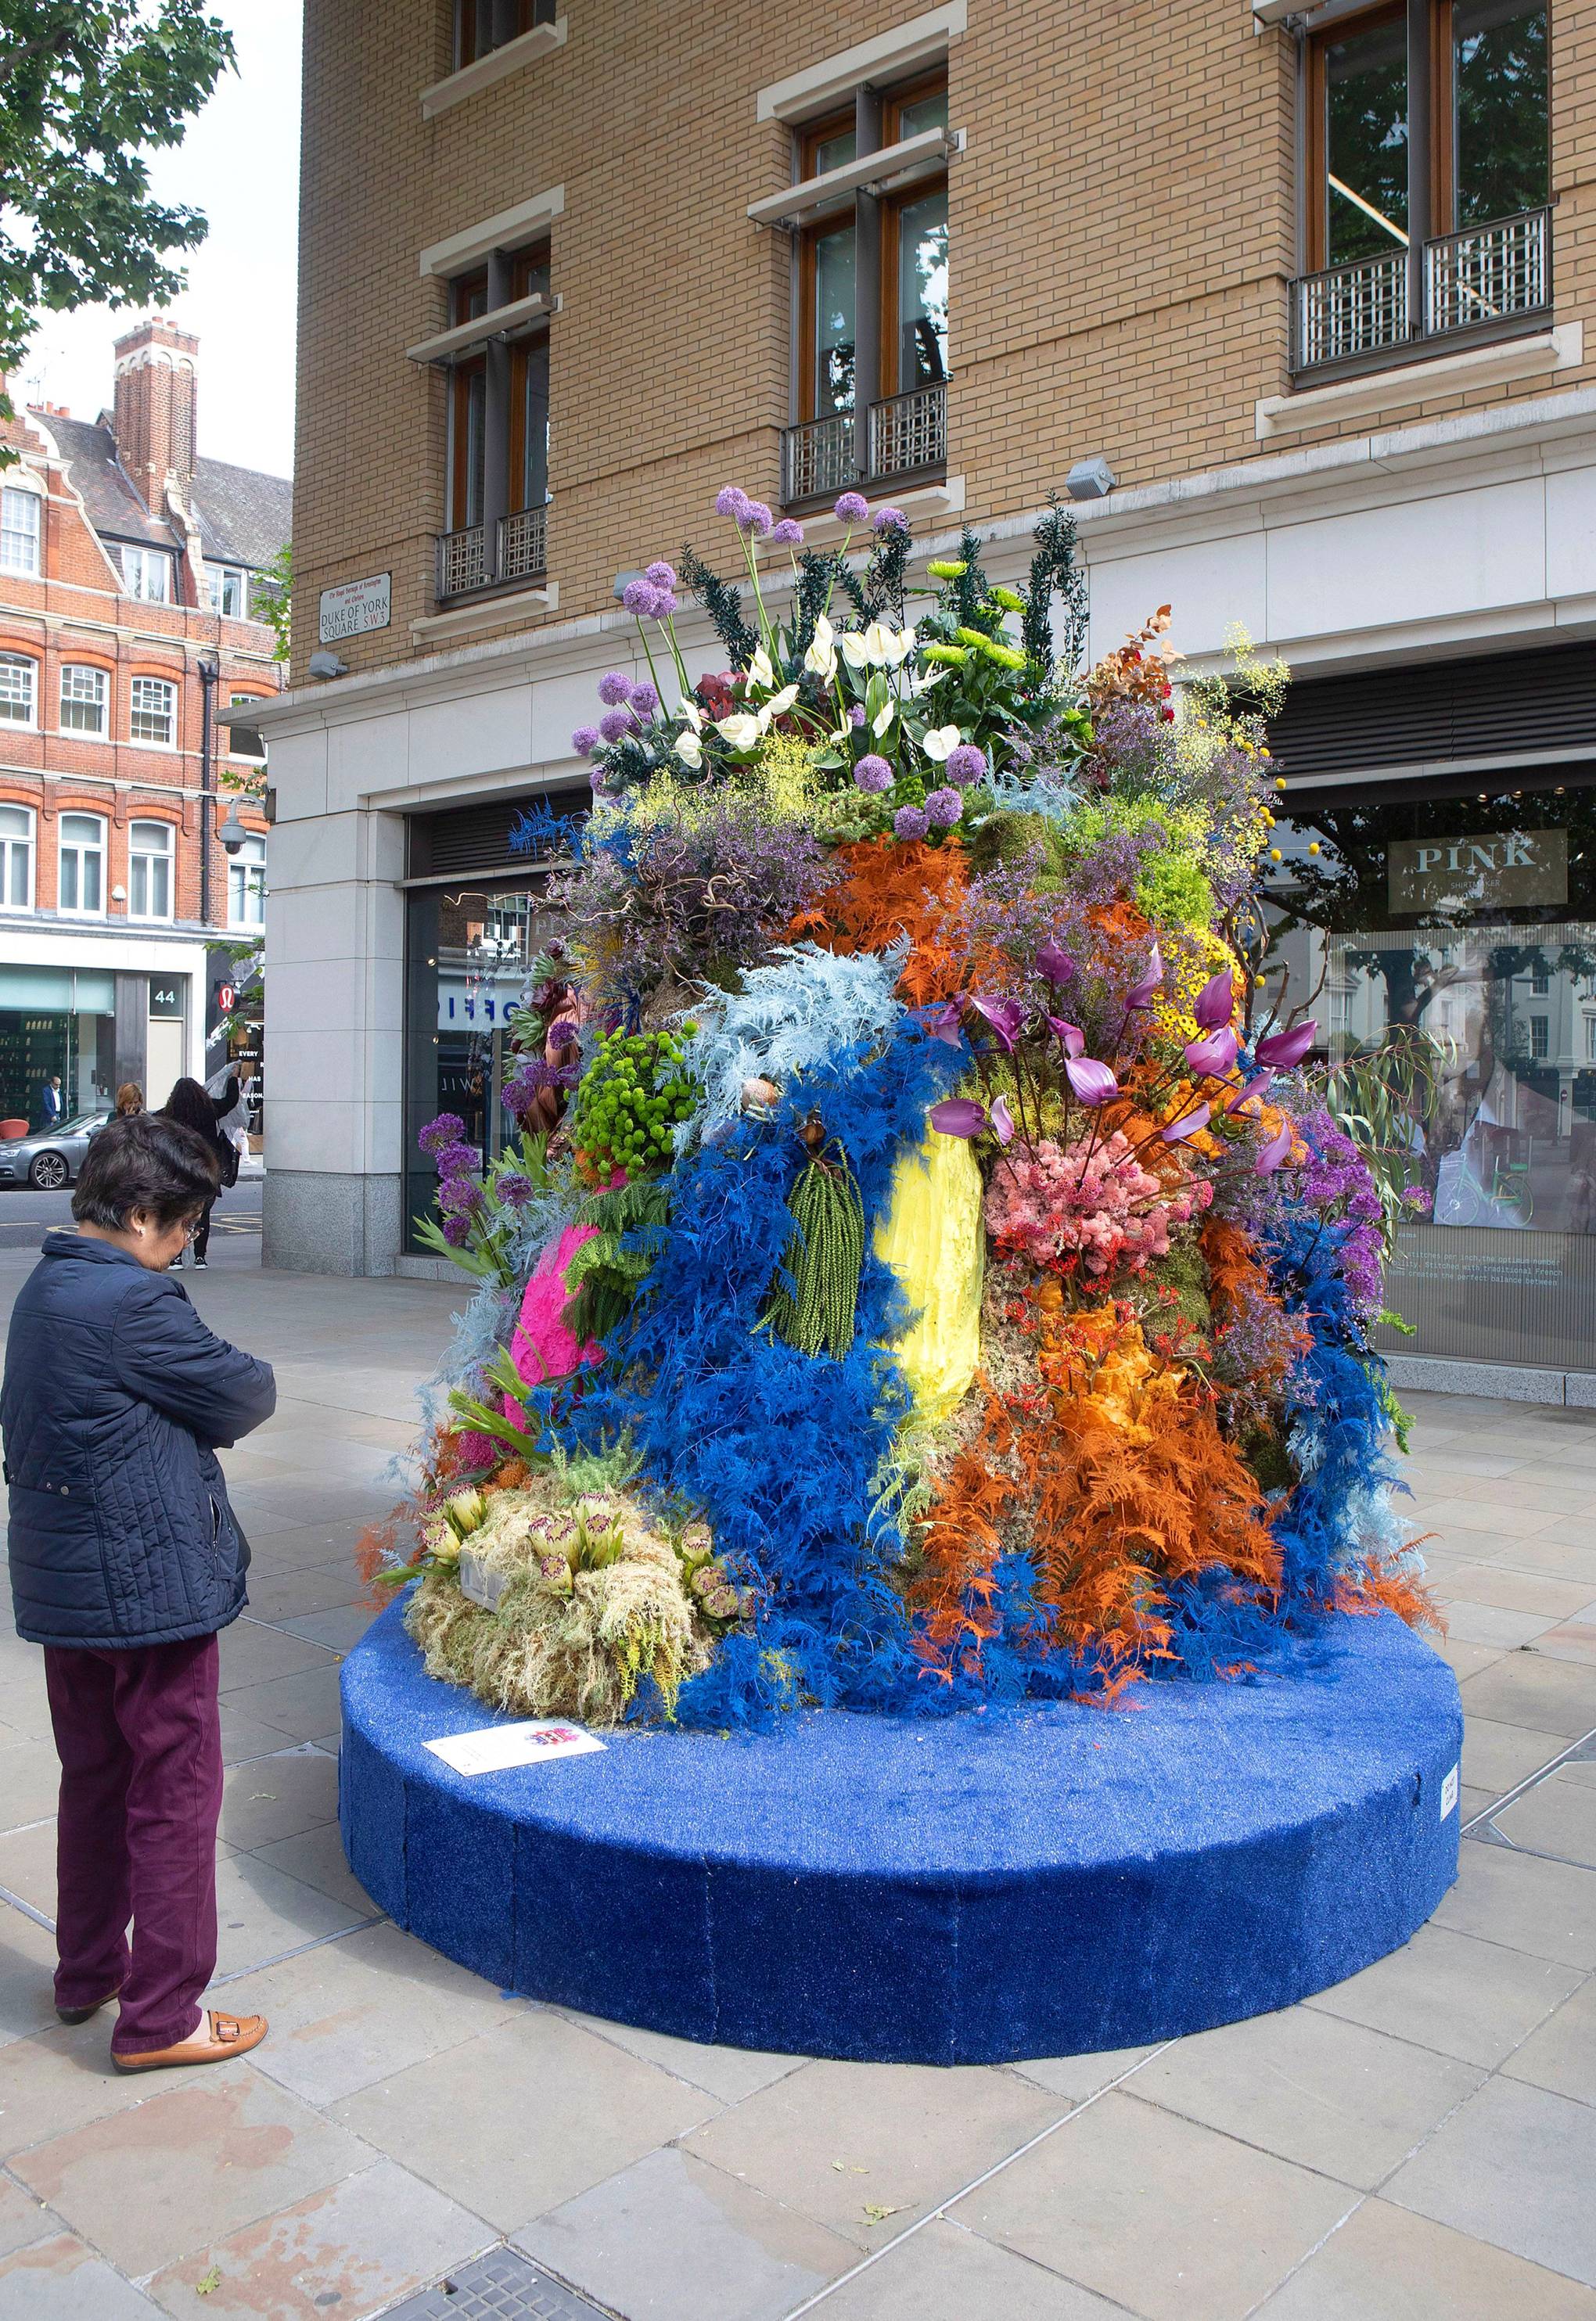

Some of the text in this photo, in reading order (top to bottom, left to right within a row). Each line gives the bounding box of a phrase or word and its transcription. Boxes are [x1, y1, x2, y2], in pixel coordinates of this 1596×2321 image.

[322, 596, 388, 627] DUKE OF YORK
[324, 612, 385, 639] SQUARE S.W.3
[1415, 843, 1537, 873] PINK
[1450, 879, 1501, 889] SHIRTMKER
[155, 990, 175, 1004] 44
[1425, 1261, 1458, 1270] Stitched
[1484, 1265, 1531, 1274] traditional
